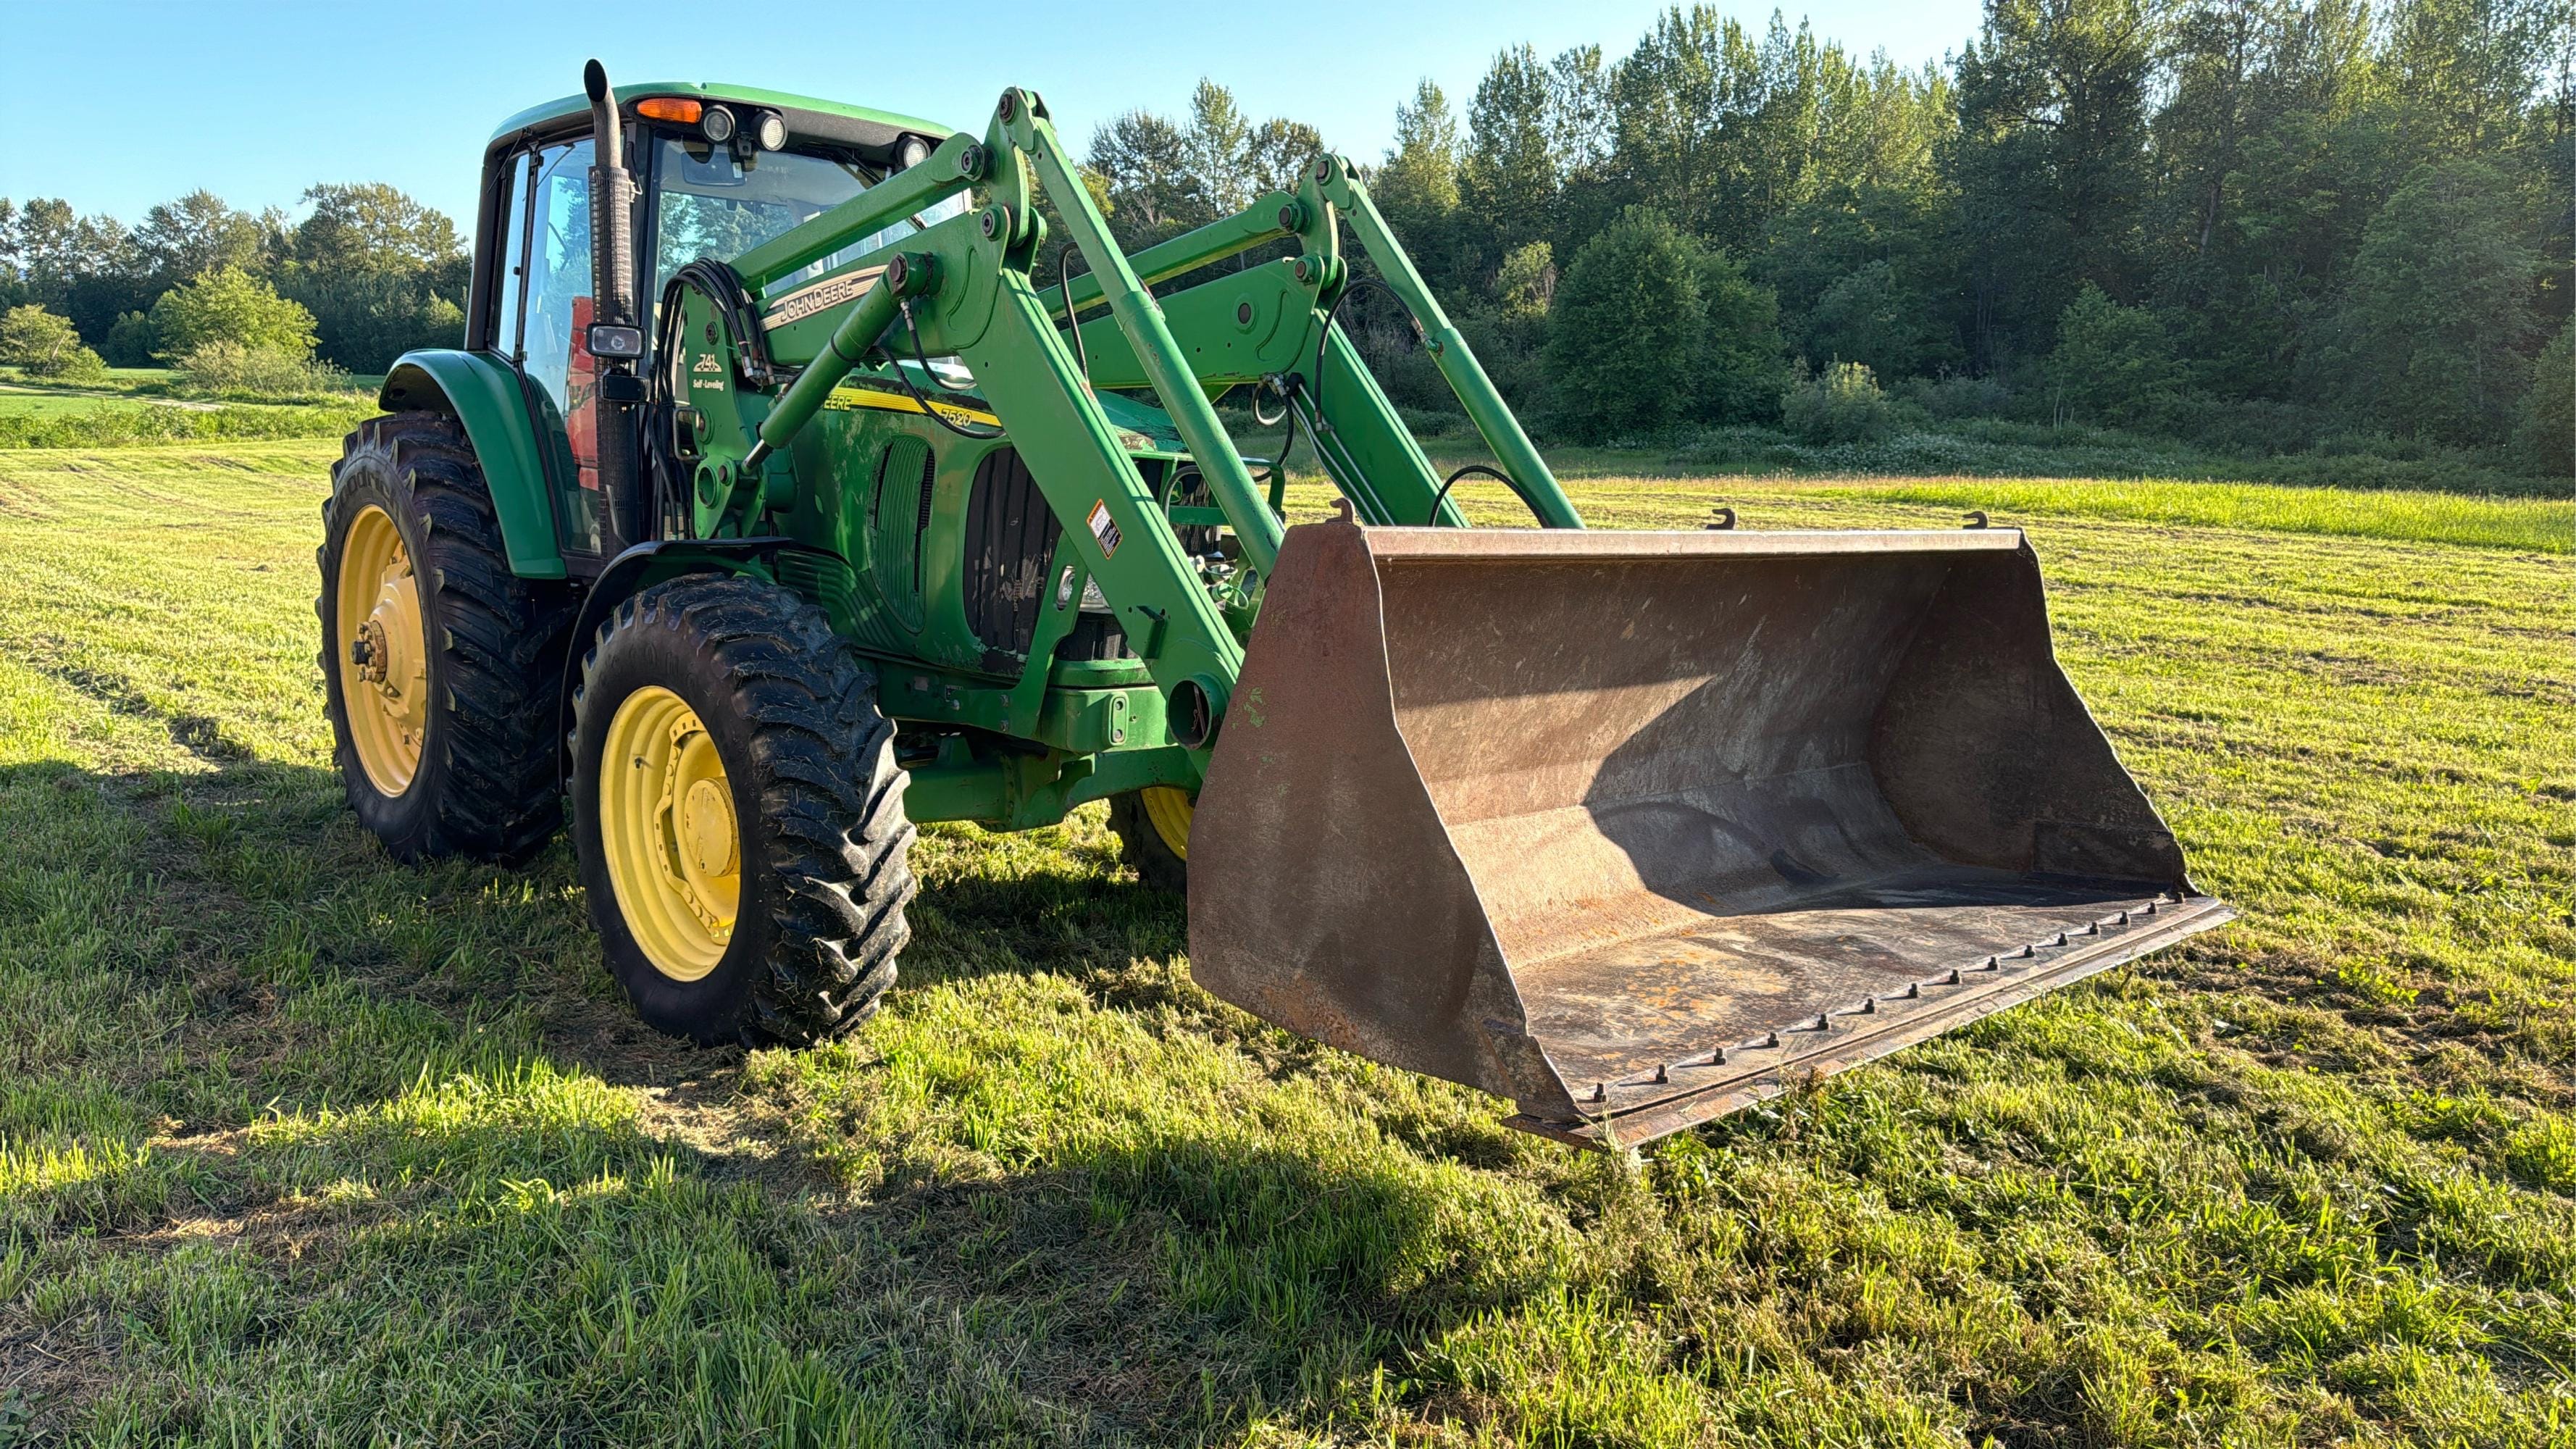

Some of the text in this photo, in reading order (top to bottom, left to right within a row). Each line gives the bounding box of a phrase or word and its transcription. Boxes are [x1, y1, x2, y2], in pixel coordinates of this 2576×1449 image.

[699, 354, 715, 371] 741
[823, 394, 853, 412] EERE
[942, 408, 972, 427] 7520
